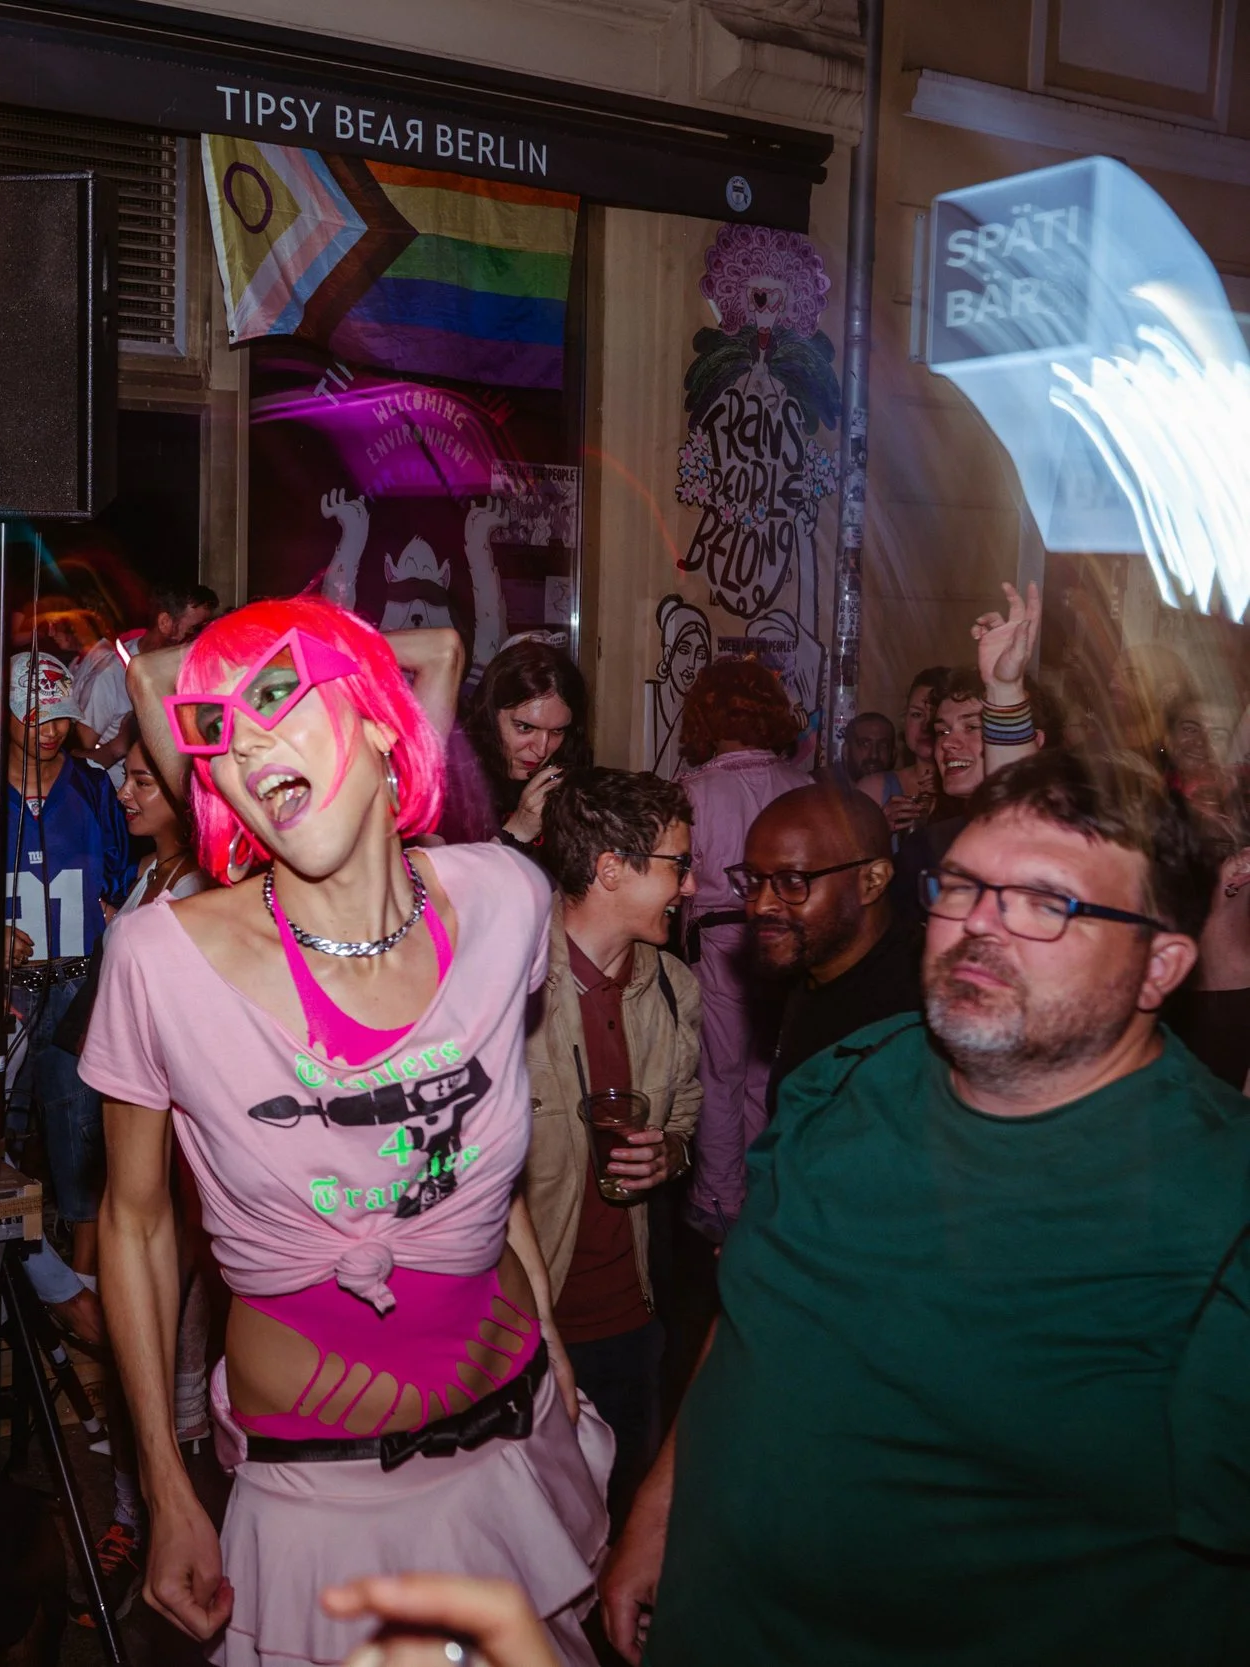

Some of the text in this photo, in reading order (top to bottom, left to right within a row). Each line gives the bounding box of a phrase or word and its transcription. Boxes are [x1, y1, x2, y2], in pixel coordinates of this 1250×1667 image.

[216, 85, 321, 134] TIPSY
[436, 124, 548, 177] BERLIN
[946, 203, 1080, 268] SPÄTI
[371, 390, 467, 432] WELCOMING
[365, 423, 475, 468] ENVIRONMENT
[548, 468, 576, 482] PEOPLE
[708, 459, 803, 518] PEOPLE
[378, 1125, 415, 1166] 4
